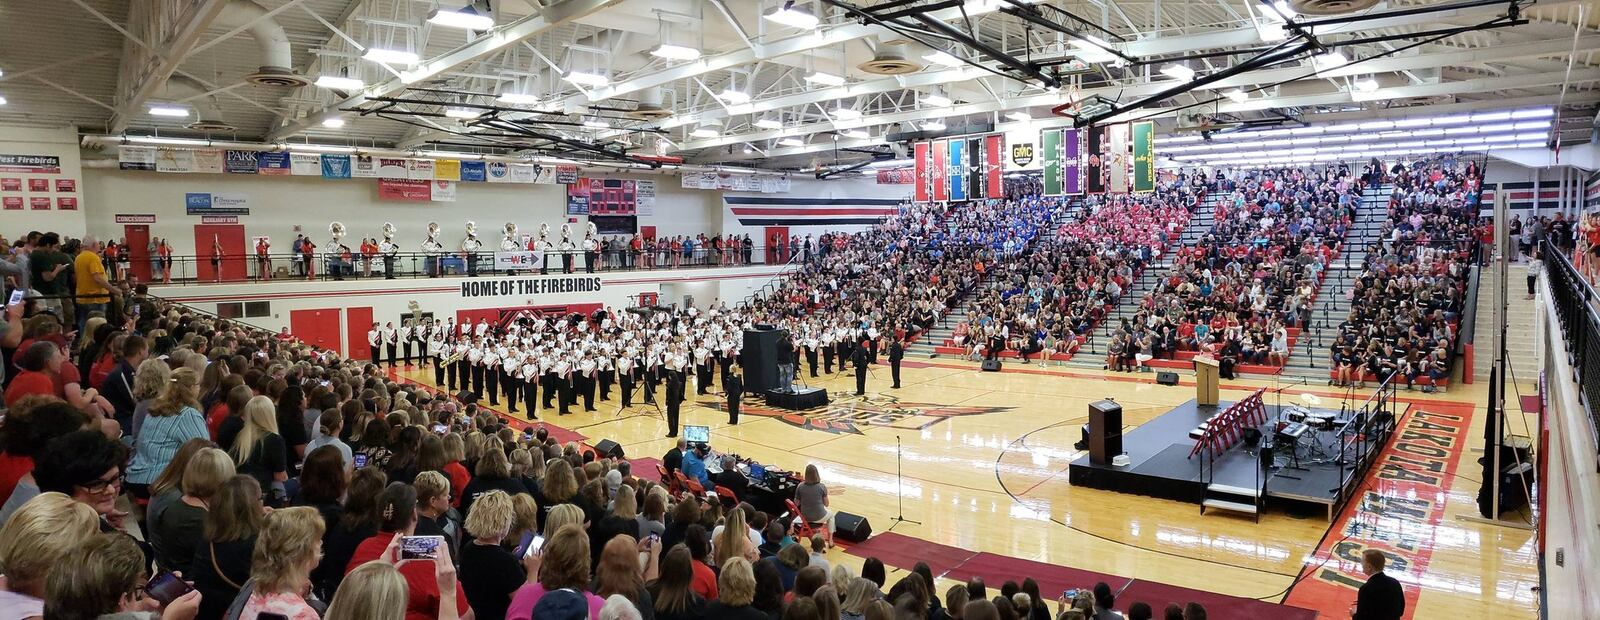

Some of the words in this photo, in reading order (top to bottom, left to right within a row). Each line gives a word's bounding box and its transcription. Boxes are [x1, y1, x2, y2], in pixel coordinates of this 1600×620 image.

[227, 151, 258, 162] PARK
[1014, 147, 1033, 157] GMC
[18, 156, 57, 164] Firebirds
[462, 281, 498, 297] HOME
[500, 280, 515, 295] OF
[517, 279, 540, 294] THE
[541, 277, 601, 293] FIREBIRDS
[1374, 410, 1463, 487] LAKOTA
